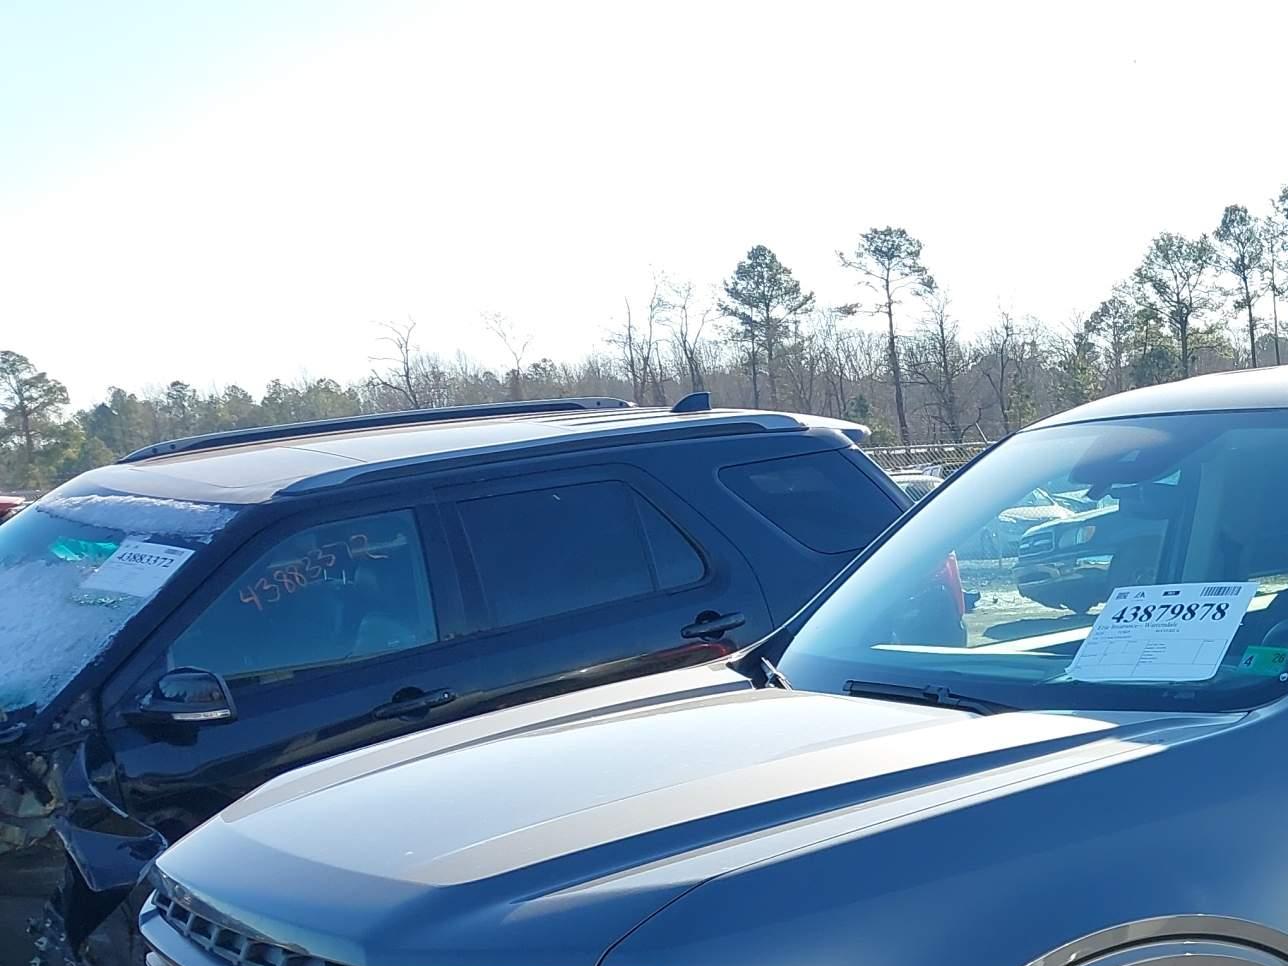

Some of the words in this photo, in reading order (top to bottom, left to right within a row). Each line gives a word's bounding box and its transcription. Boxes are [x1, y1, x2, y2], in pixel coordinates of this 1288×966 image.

[117, 551, 175, 568] 43883372
[239, 533, 389, 611] 43883372
[1111, 602, 1230, 623] 43879878
[1243, 655, 1254, 667] 4
